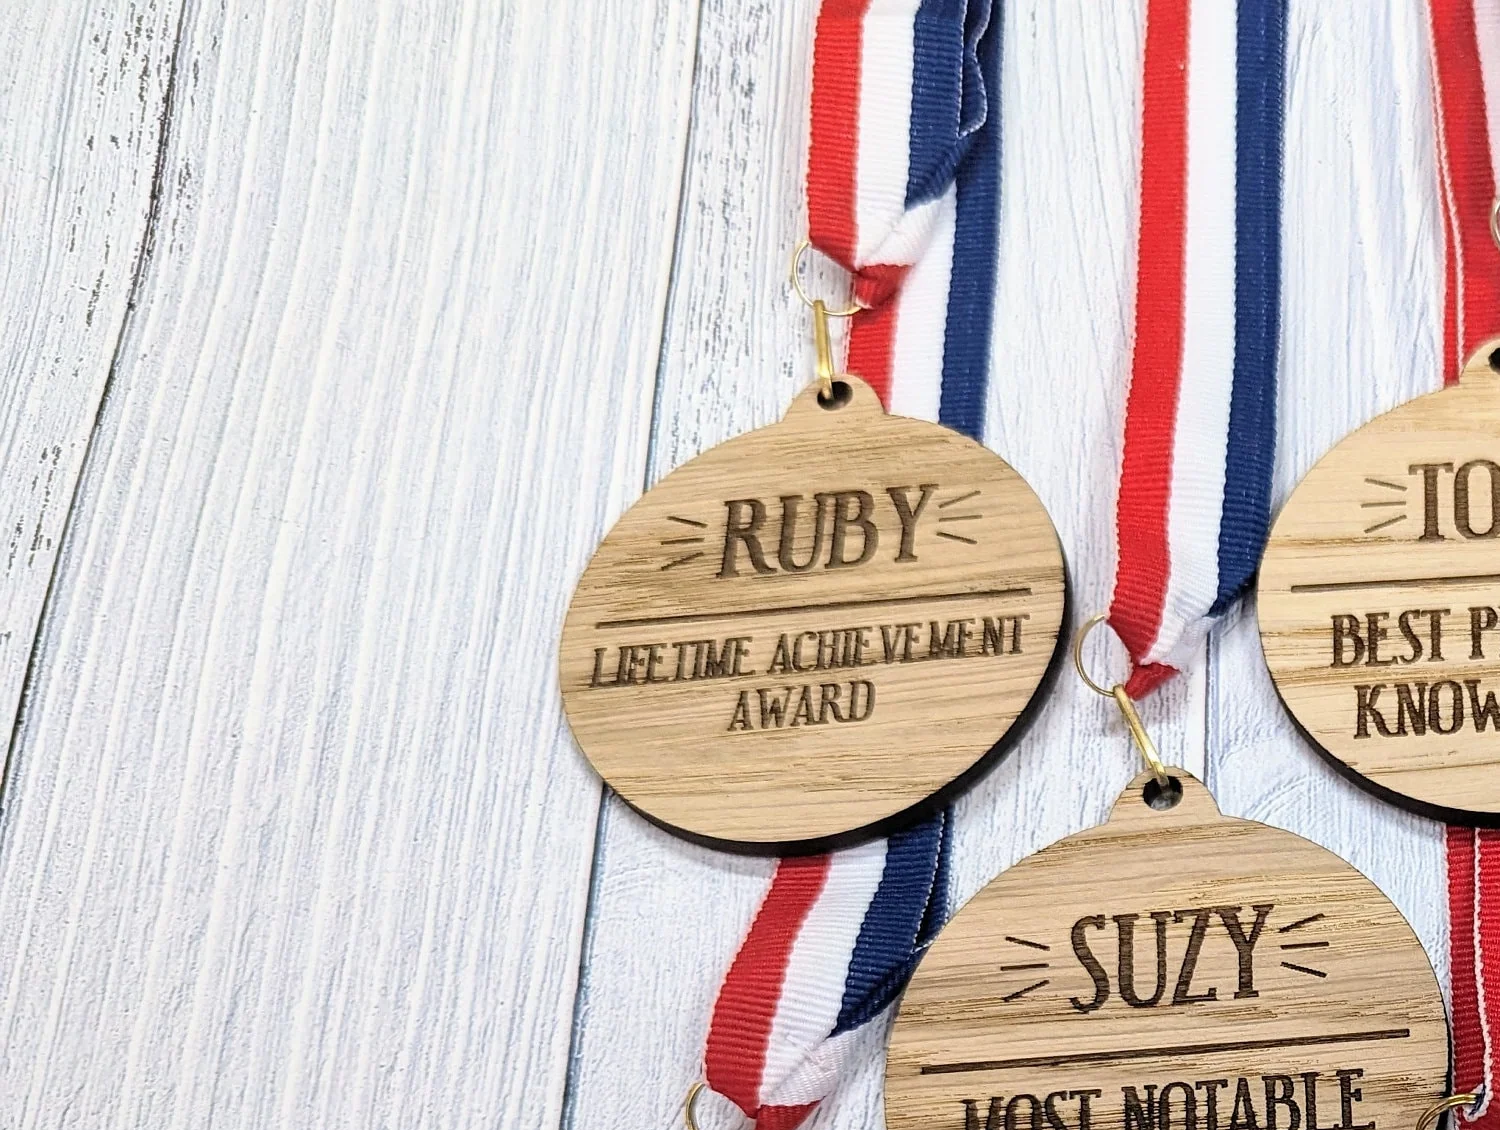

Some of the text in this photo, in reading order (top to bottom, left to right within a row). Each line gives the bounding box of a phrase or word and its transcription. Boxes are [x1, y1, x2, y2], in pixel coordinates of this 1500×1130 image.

[716, 483, 938, 579] RUBY
[590, 613, 1031, 688] LIFETIME ACHIEVEMENT
[1330, 608, 1451, 669] BEST
[727, 680, 876, 732] AWARD
[1069, 903, 1275, 1014] SUZY
